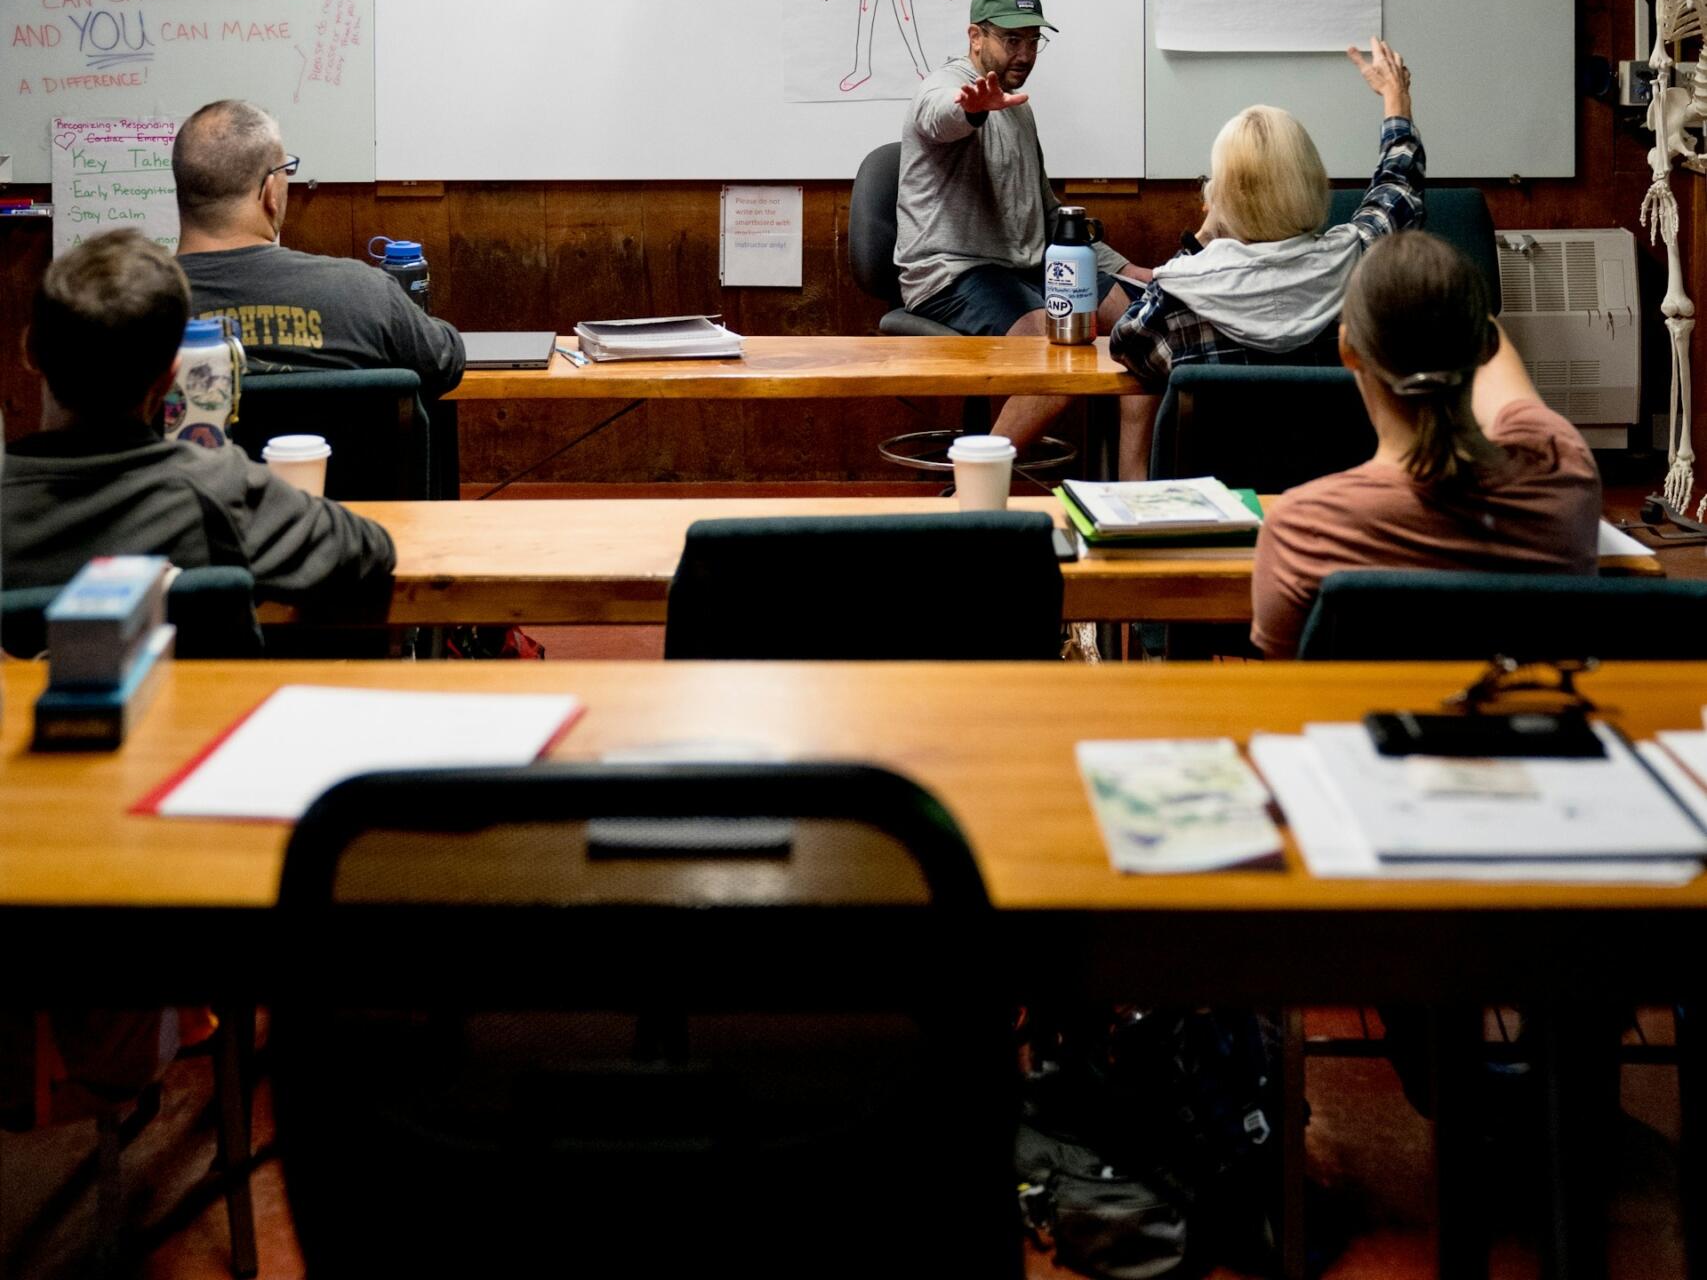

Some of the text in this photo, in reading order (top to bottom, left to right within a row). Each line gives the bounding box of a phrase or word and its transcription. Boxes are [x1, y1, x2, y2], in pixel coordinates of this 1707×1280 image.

[12, 10, 293, 53] AND YOU CAN MAKE
[19, 67, 149, 95] A DIFFERENCE!
[55, 118, 112, 133] Recognizing
[119, 119, 174, 135] Responding
[72, 148, 108, 174] Key
[73, 180, 109, 200] Early
[70, 206, 146, 224] Stay Calm
[1048, 300, 1068, 311] ANP
